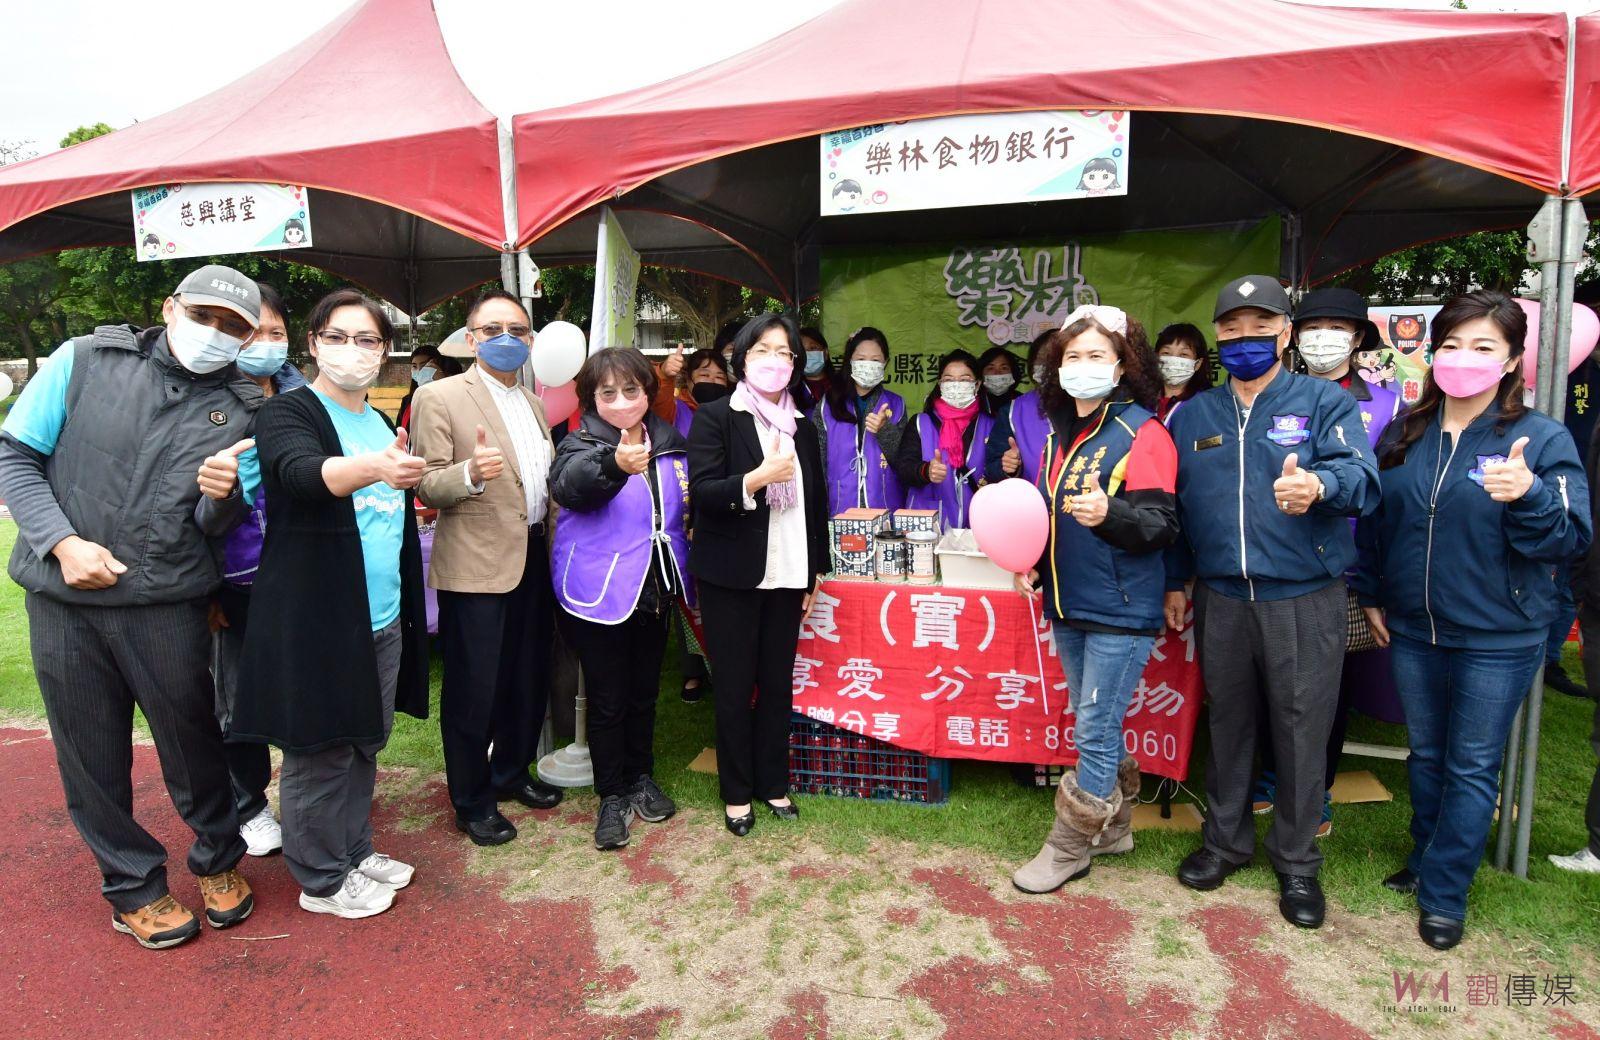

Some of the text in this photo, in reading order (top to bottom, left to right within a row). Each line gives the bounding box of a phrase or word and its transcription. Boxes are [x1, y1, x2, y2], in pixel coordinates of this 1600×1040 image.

[864, 126, 1075, 175] 樂林食物銀行
[180, 195, 256, 228] 慈興講堂
[1397, 339, 1417, 348] POLICE
[1573, 383, 1589, 415] 刑警
